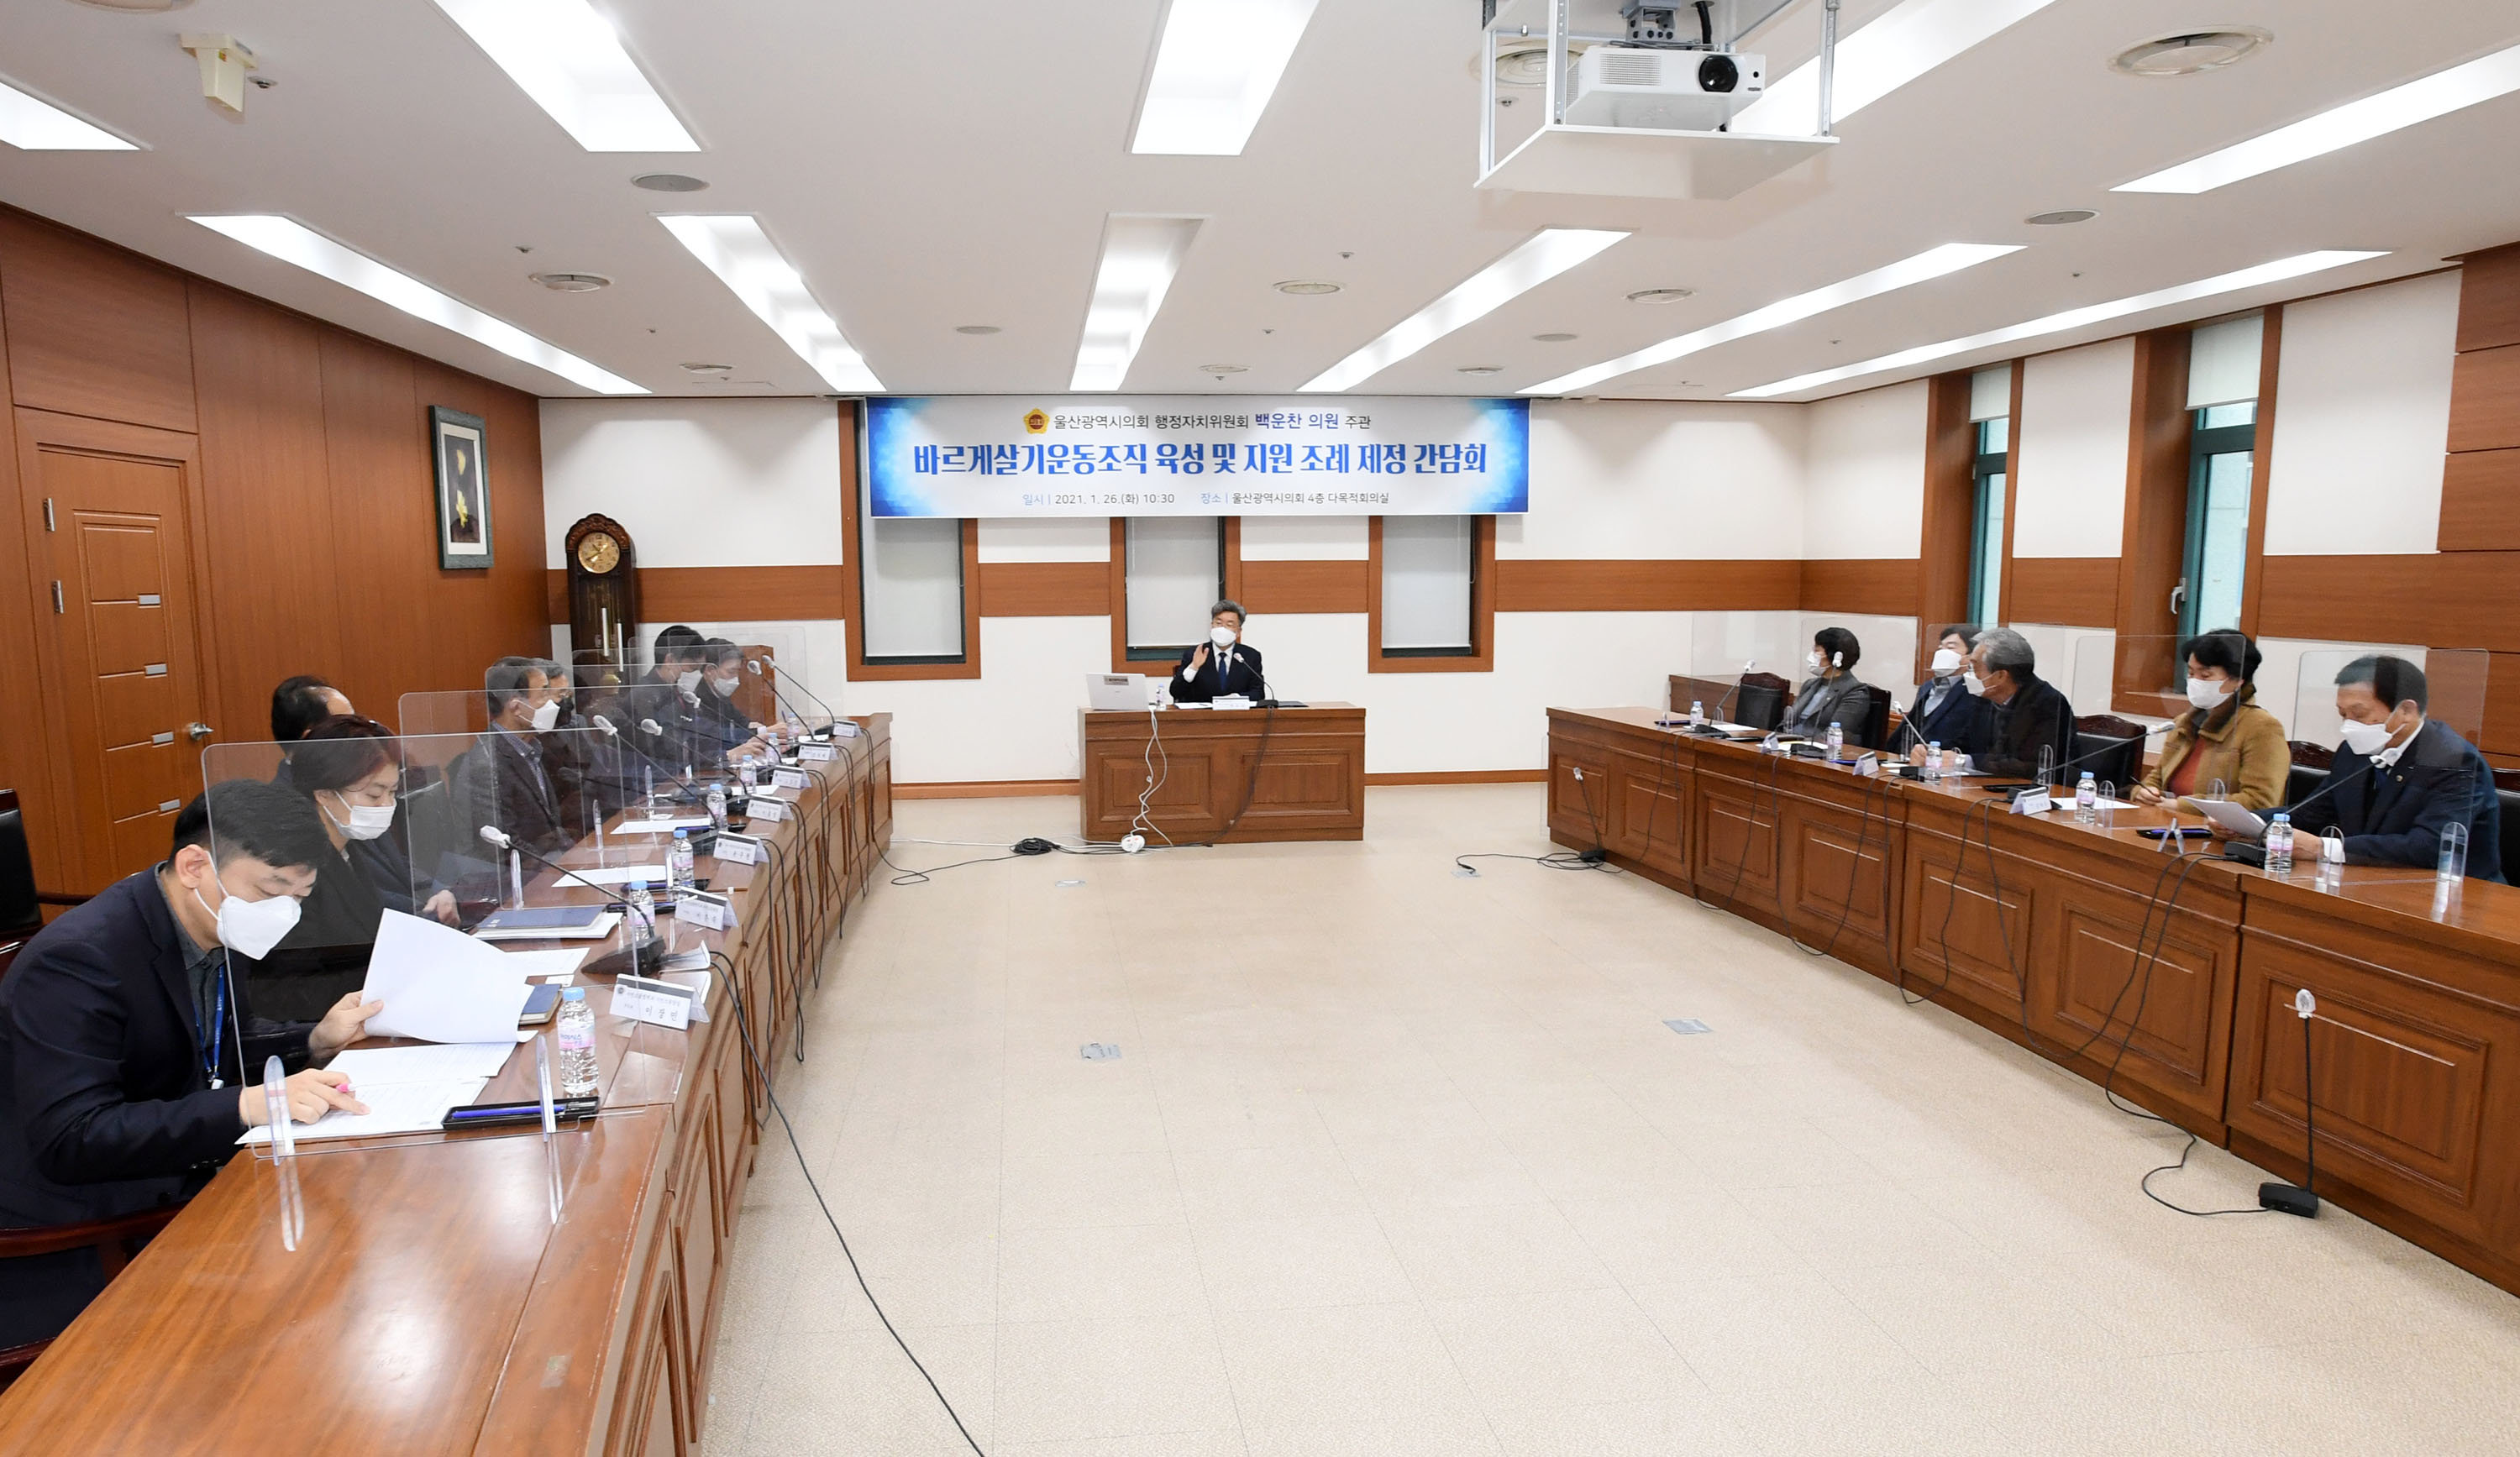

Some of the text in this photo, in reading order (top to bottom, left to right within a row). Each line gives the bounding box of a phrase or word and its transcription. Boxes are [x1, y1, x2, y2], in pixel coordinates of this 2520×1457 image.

[1054, 413, 1371, 429] 울산광역시의회 행정자치위원회 백운찬 의원 주관
[914, 443, 1486, 475] 바르게살기운동조직 육성 및 지원 조례 제정 간담회
[1022, 494, 1044, 506] 일시
[1143, 494, 1174, 503] 10:30
[1200, 493, 1389, 504] 장소 울산광역시의회 4층 다목적회의실
